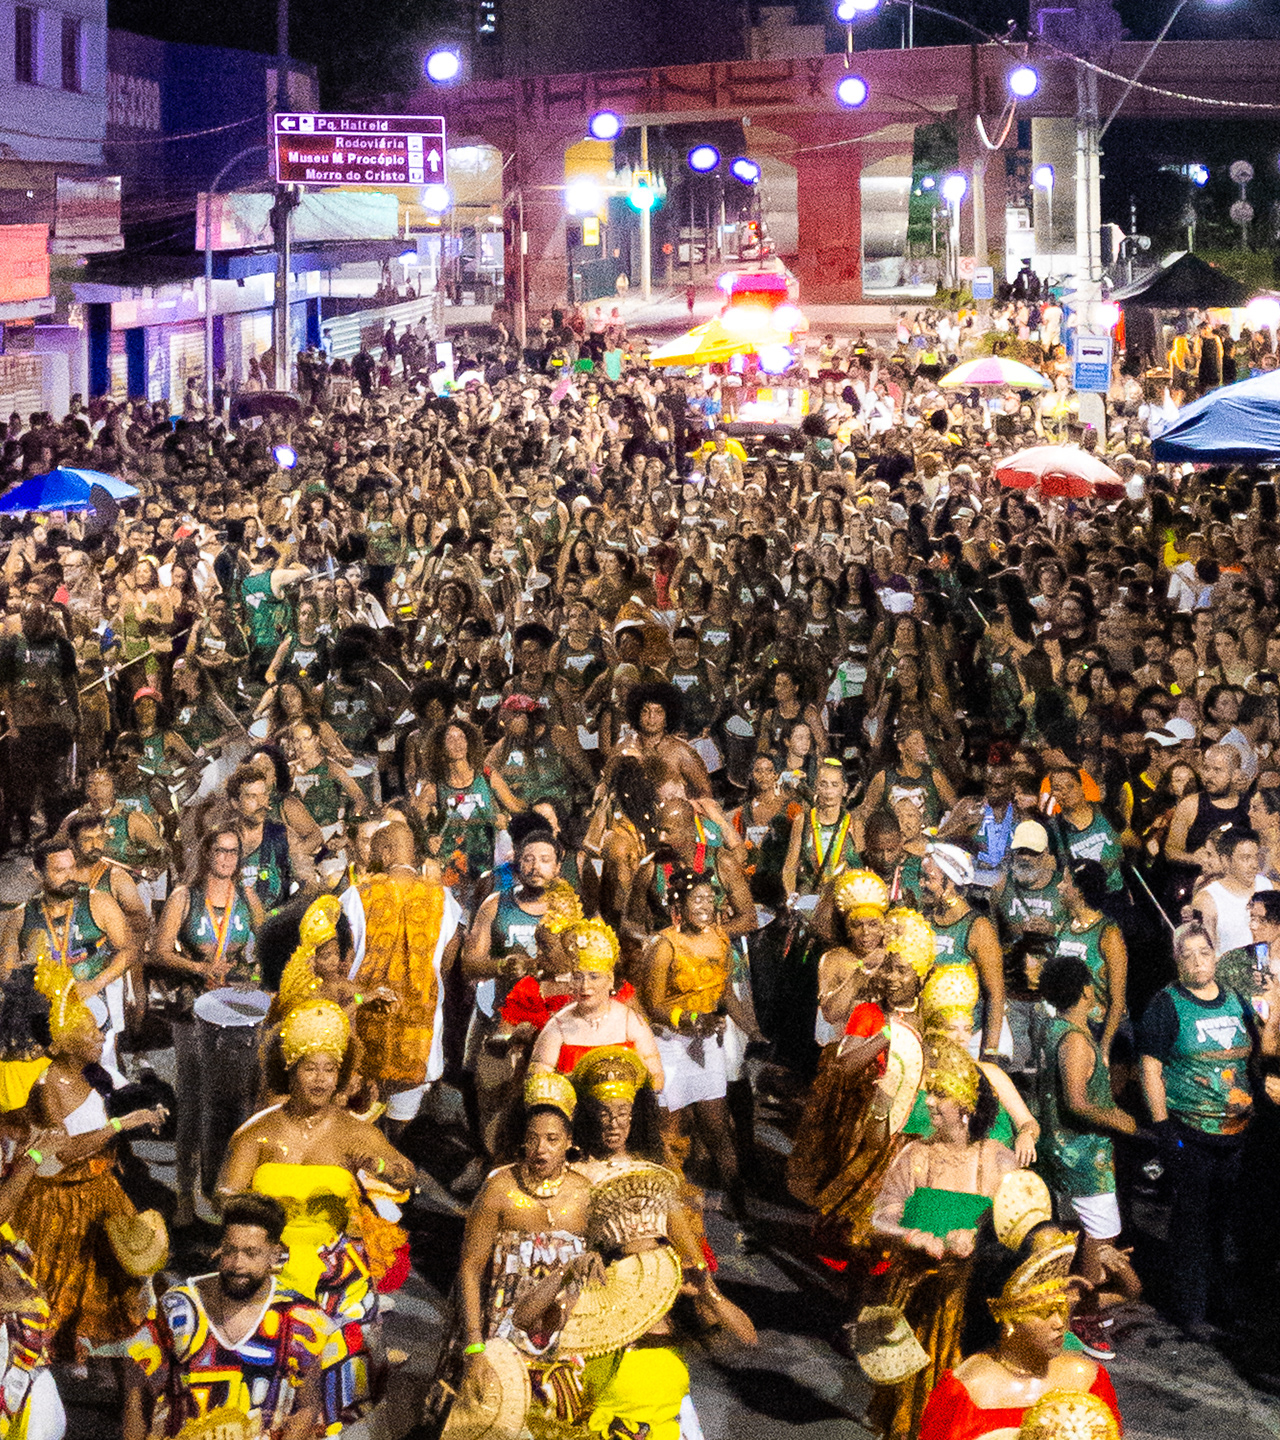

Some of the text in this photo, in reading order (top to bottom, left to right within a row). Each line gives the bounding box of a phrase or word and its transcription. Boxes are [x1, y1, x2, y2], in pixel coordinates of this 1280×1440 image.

[340, 119, 389, 132] Halfeld
[335, 137, 405, 149] Rodoviária
[288, 152, 329, 164] Museu
[347, 152, 405, 166] Procópio
[305, 169, 406, 182] Morro do Cristo
